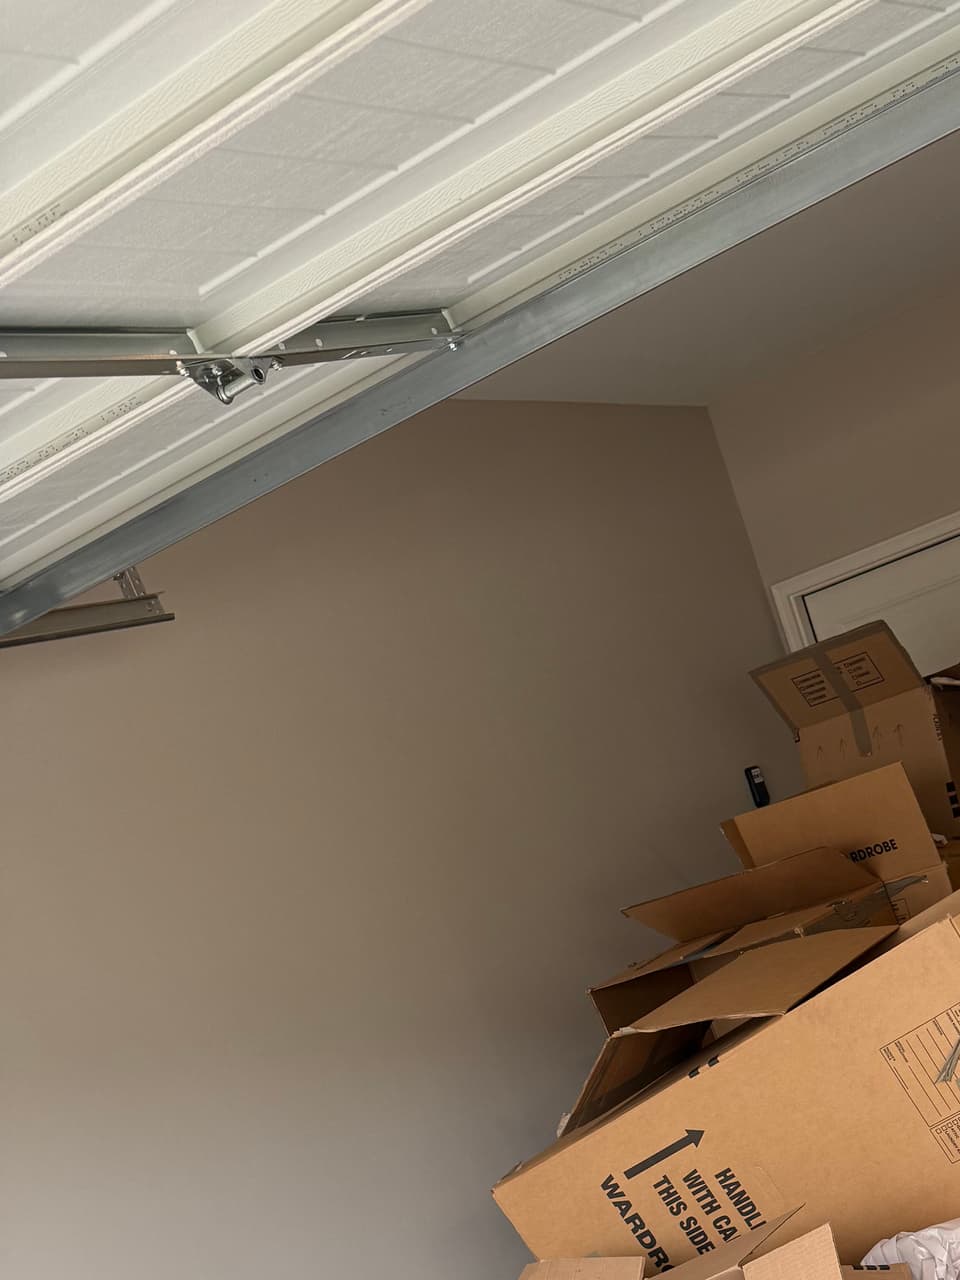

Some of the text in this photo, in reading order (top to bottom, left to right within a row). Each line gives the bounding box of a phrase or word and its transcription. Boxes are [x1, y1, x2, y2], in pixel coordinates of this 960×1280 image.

[849, 838, 899, 863] RDROBE
[652, 1174, 716, 1255] THIS SIDE
[682, 1168, 722, 1216] WITH
